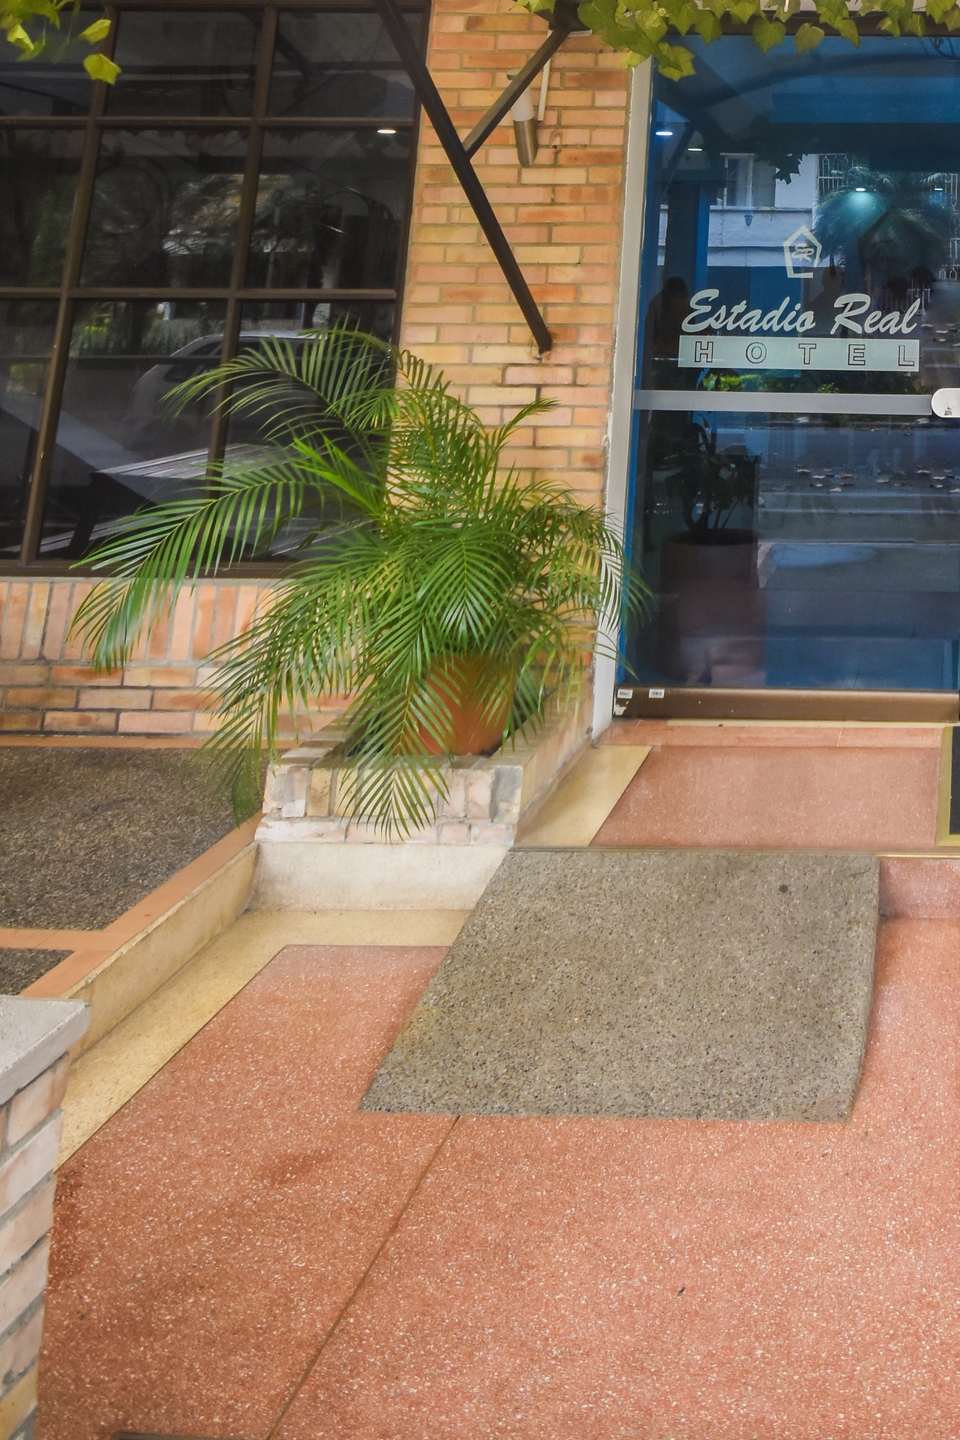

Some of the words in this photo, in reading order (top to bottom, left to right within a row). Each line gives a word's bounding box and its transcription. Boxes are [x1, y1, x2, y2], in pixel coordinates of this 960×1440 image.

[681, 289, 817, 334] Estadio
[829, 293, 921, 335] Real
[694, 340, 915, 368] HOTEL
